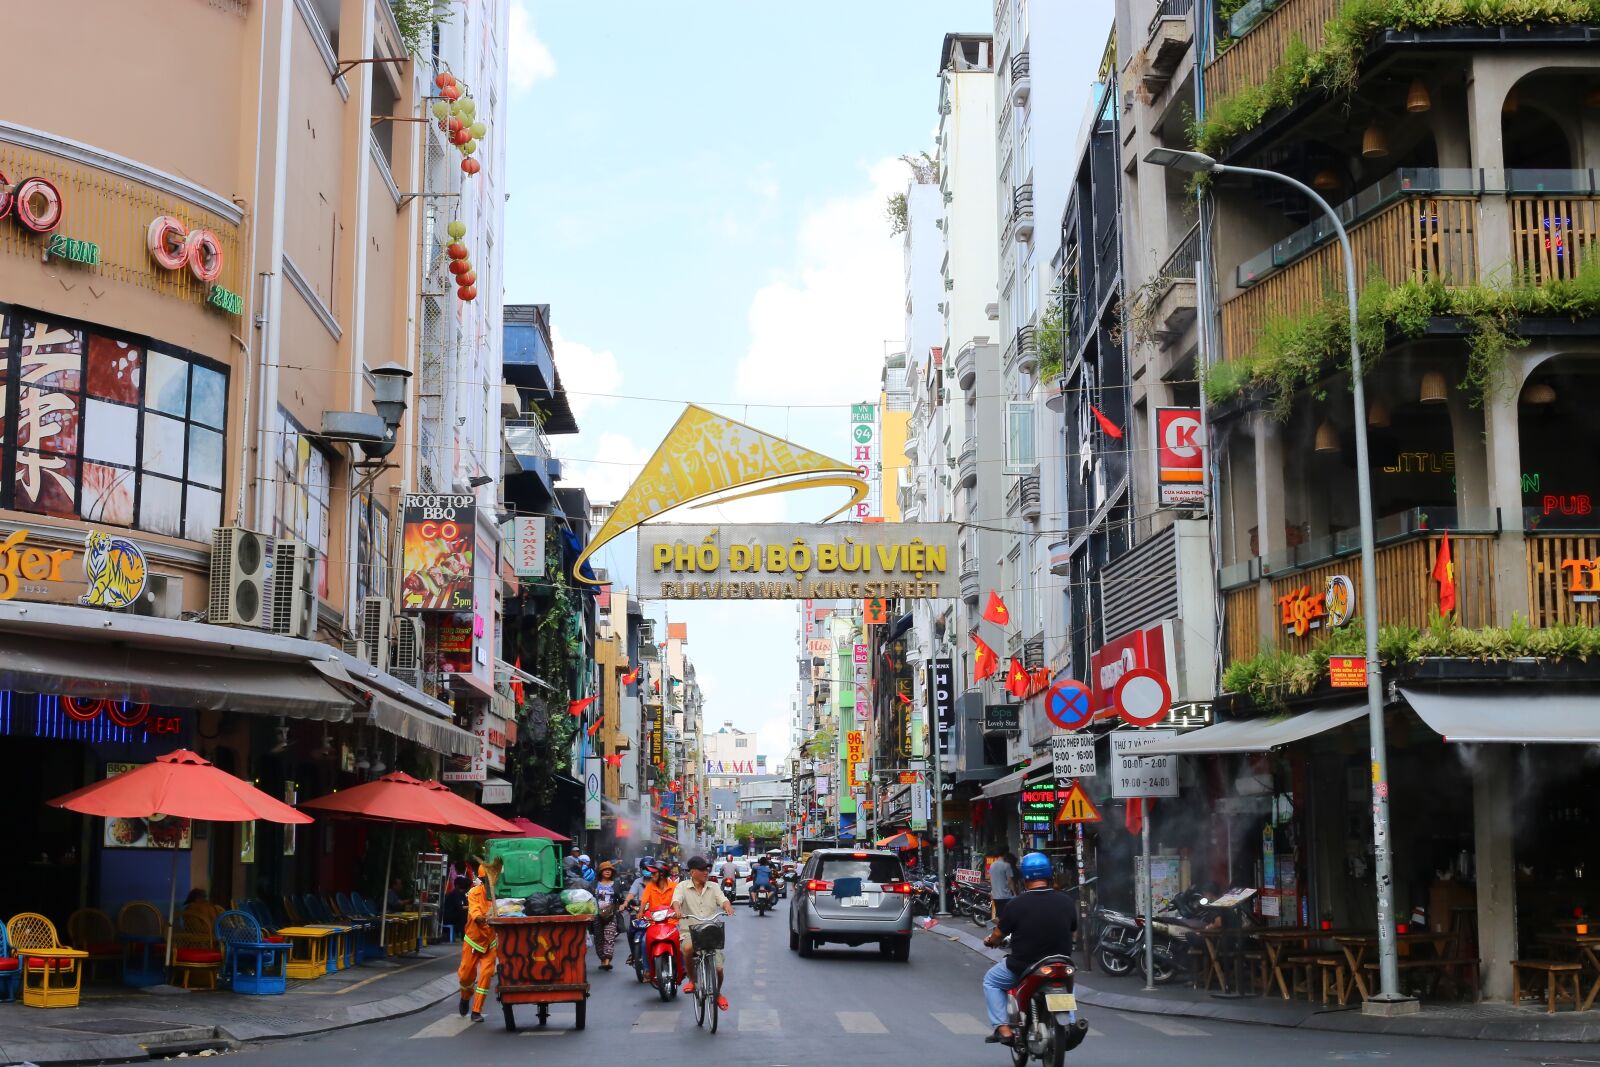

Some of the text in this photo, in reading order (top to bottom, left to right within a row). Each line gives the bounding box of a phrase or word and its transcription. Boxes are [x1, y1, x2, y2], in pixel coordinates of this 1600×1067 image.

[852, 413, 872, 421] PEARL
[855, 428, 871, 439] 94
[406, 495, 474, 508] ROOFTOP
[1543, 495, 1592, 515] PUB
[423, 507, 456, 520] BBQ
[653, 527, 720, 572] PHỐ
[767, 537, 811, 580] BỘ
[817, 536, 871, 572] BÙI
[877, 536, 947, 579] VIỆN
[23, 585, 48, 594] 1932
[661, 581, 940, 599] BUI VIEN WALKING STREET
[453, 591, 472, 608] 5pm
[1279, 585, 1326, 637] Tiger
[935, 674, 948, 749] HOTEL
[157, 716, 183, 735] EAT
[987, 720, 1004, 728] Lovely
[847, 732, 861, 745] 96
[1054, 751, 1070, 761] 9:00
[1076, 750, 1094, 760] 16:00
[1054, 765, 1072, 775] 19:00
[1079, 763, 1094, 773] 6:00
[1122, 759, 1143, 769] 00:00
[1151, 758, 1167, 768] 2:00
[1121, 778, 1141, 788] 19:00
[1149, 777, 1170, 788] 24:00
